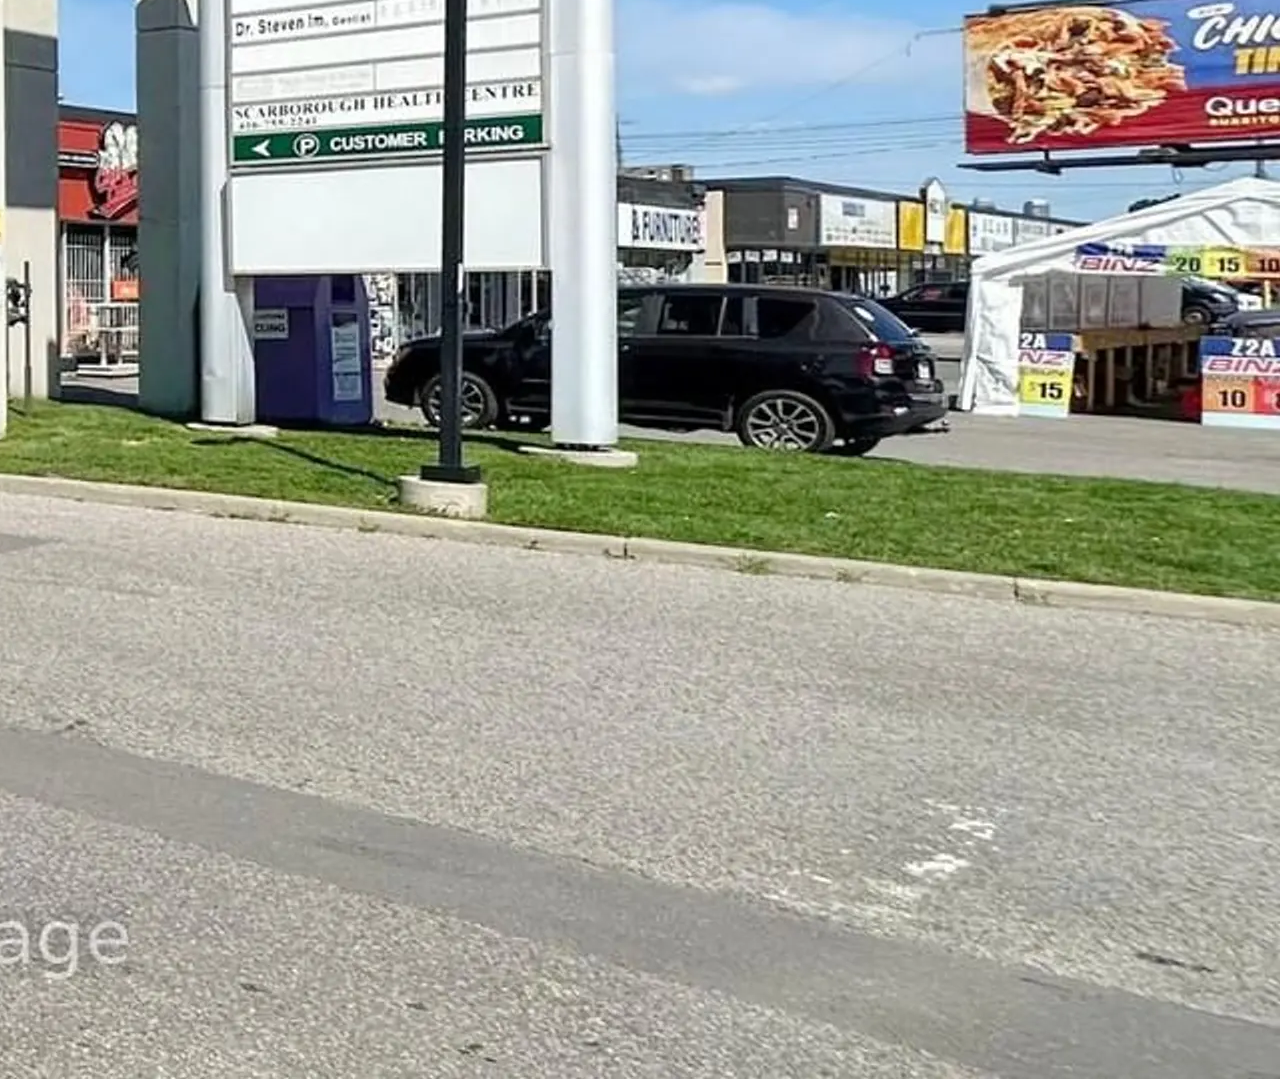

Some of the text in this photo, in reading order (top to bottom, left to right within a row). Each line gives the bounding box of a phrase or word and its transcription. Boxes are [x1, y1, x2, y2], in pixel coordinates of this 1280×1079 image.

[258, 18, 305, 35] Steven
[235, 98, 366, 121] SCARBOROUGH
[466, 80, 539, 103] ENTRE
[329, 131, 428, 151] CUSTOMER
[439, 125, 524, 145] RKING
[1175, 257, 1202, 273] 20
[1231, 338, 1276, 357] Z2A
[1218, 388, 1246, 408] 10
